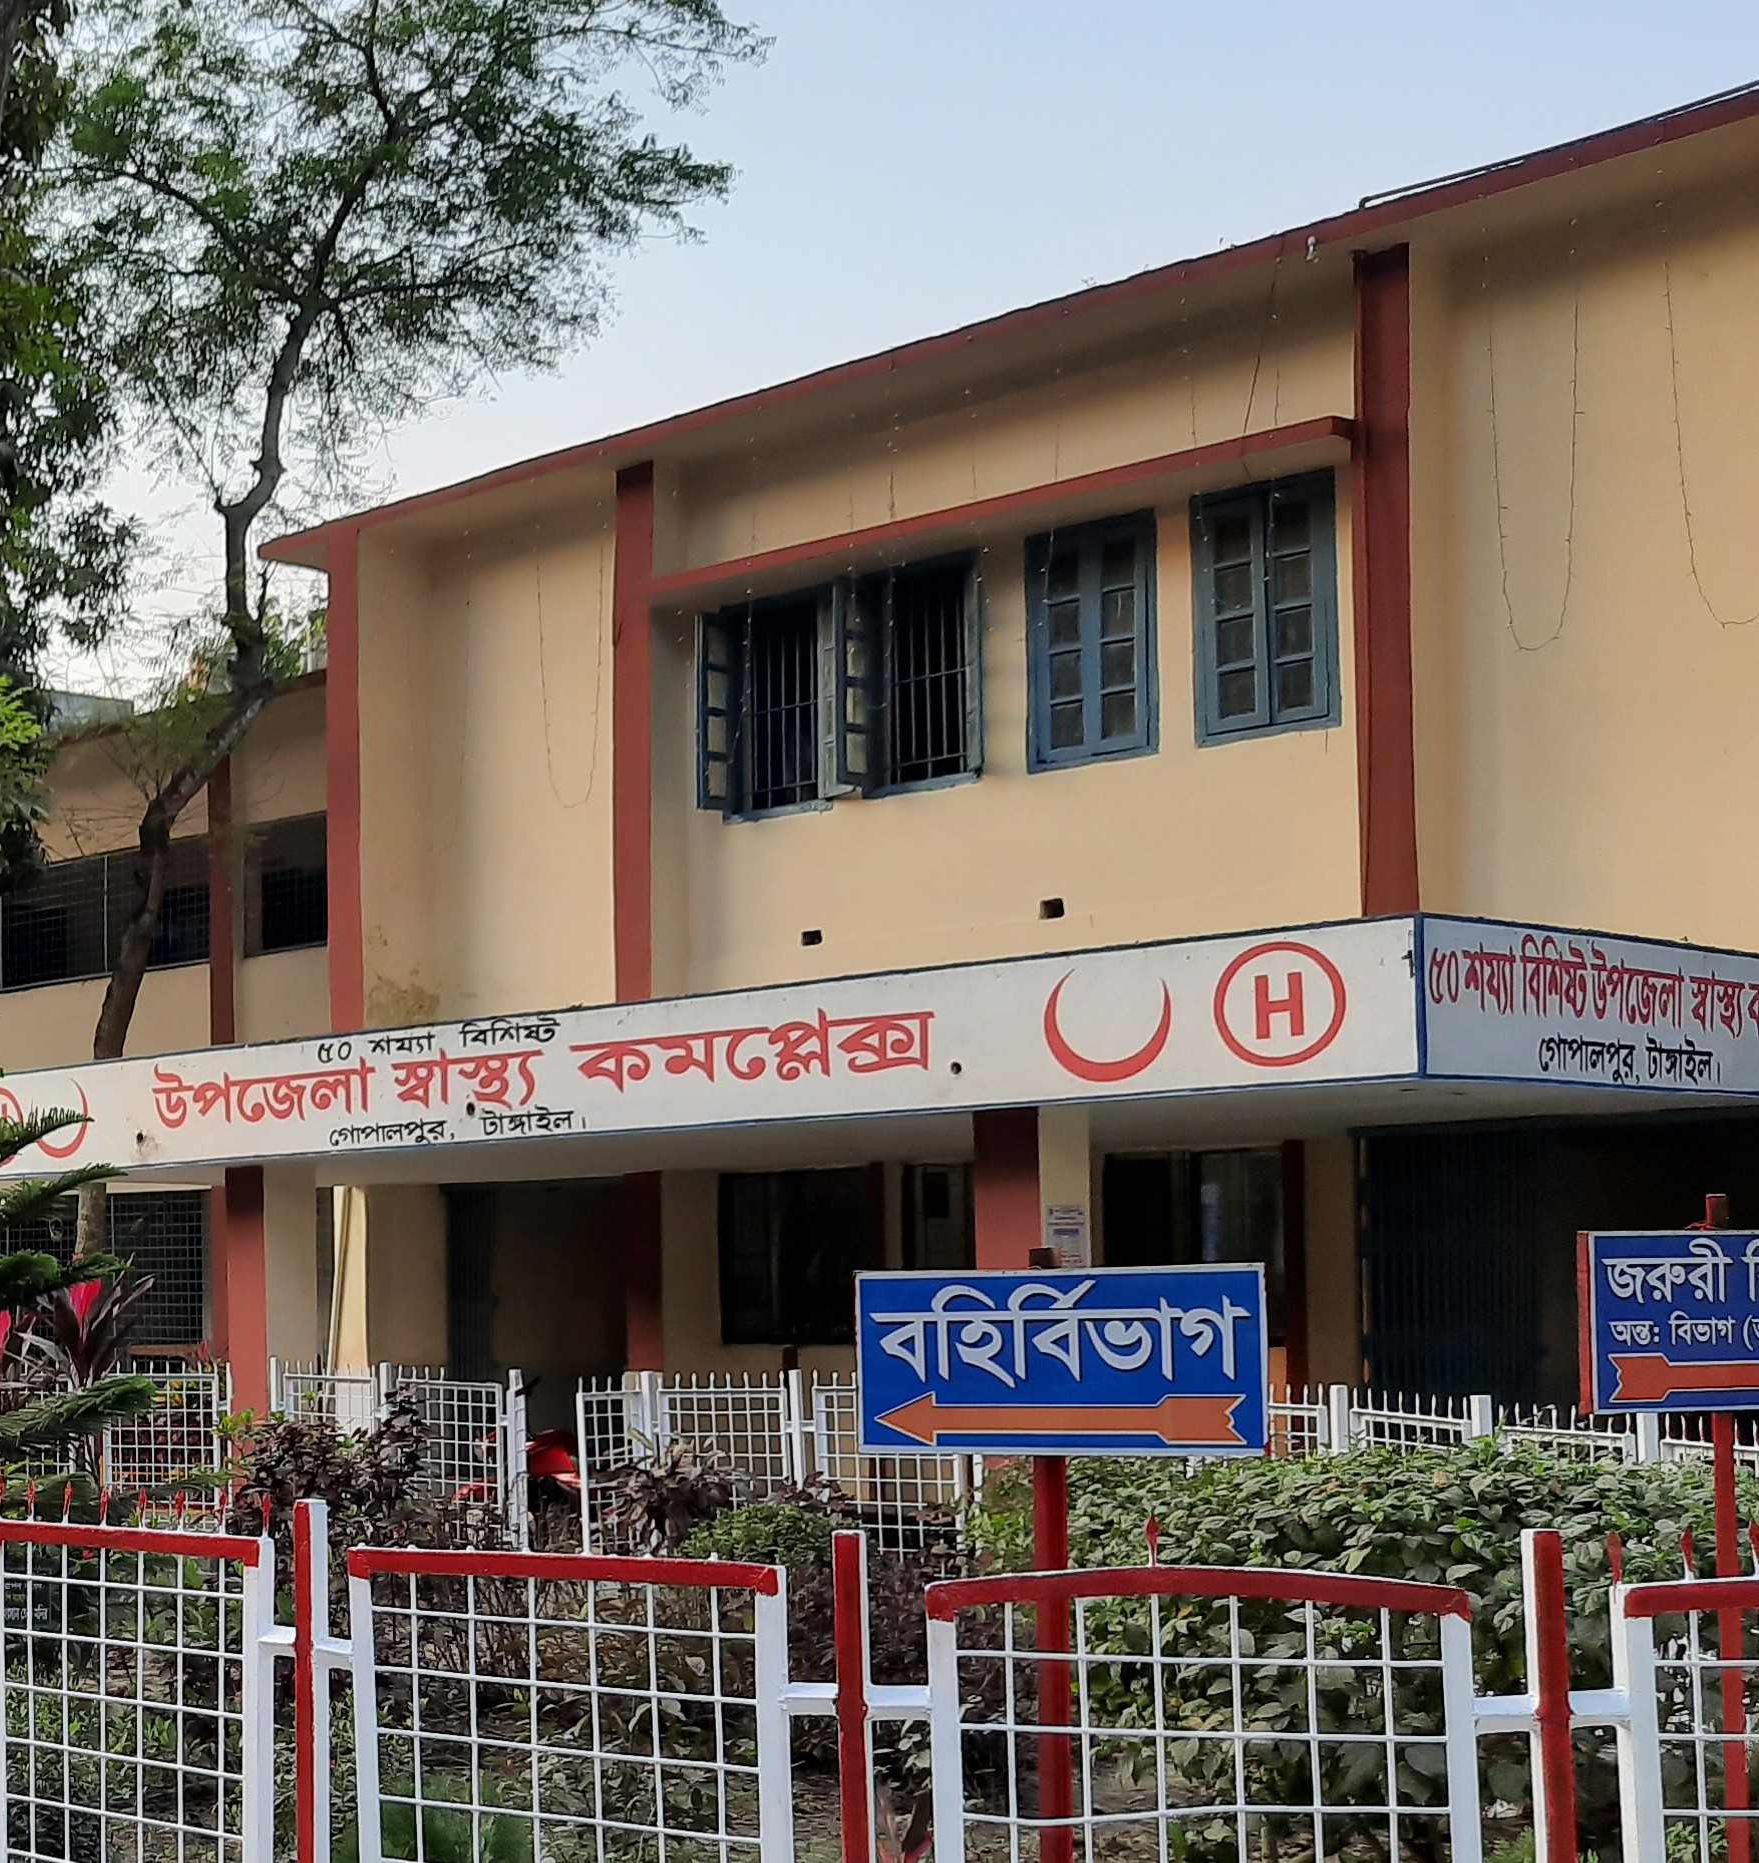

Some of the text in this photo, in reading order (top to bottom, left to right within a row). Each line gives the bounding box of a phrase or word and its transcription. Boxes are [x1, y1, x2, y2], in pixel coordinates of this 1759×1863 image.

[1255, 971, 1306, 1040] H
[1429, 947, 1460, 1004] ৫০
[1519, 934, 1588, 1019] বিশিষ্ট
[1590, 939, 1684, 1029] উপজেলা
[1689, 970, 1745, 1039] স্বাস্থ্য
[152, 1008, 935, 1129] উপজেলা স্বাস্থ্য কমপ্লেক্স
[317, 1018, 560, 1063] ৫০ শয্যা বিশিষ্ট
[1601, 1237, 1734, 1304] জরুরী
[870, 1279, 1252, 1389] বহির্বিভাগ
[1668, 1310, 1736, 1346] বিভাগ
